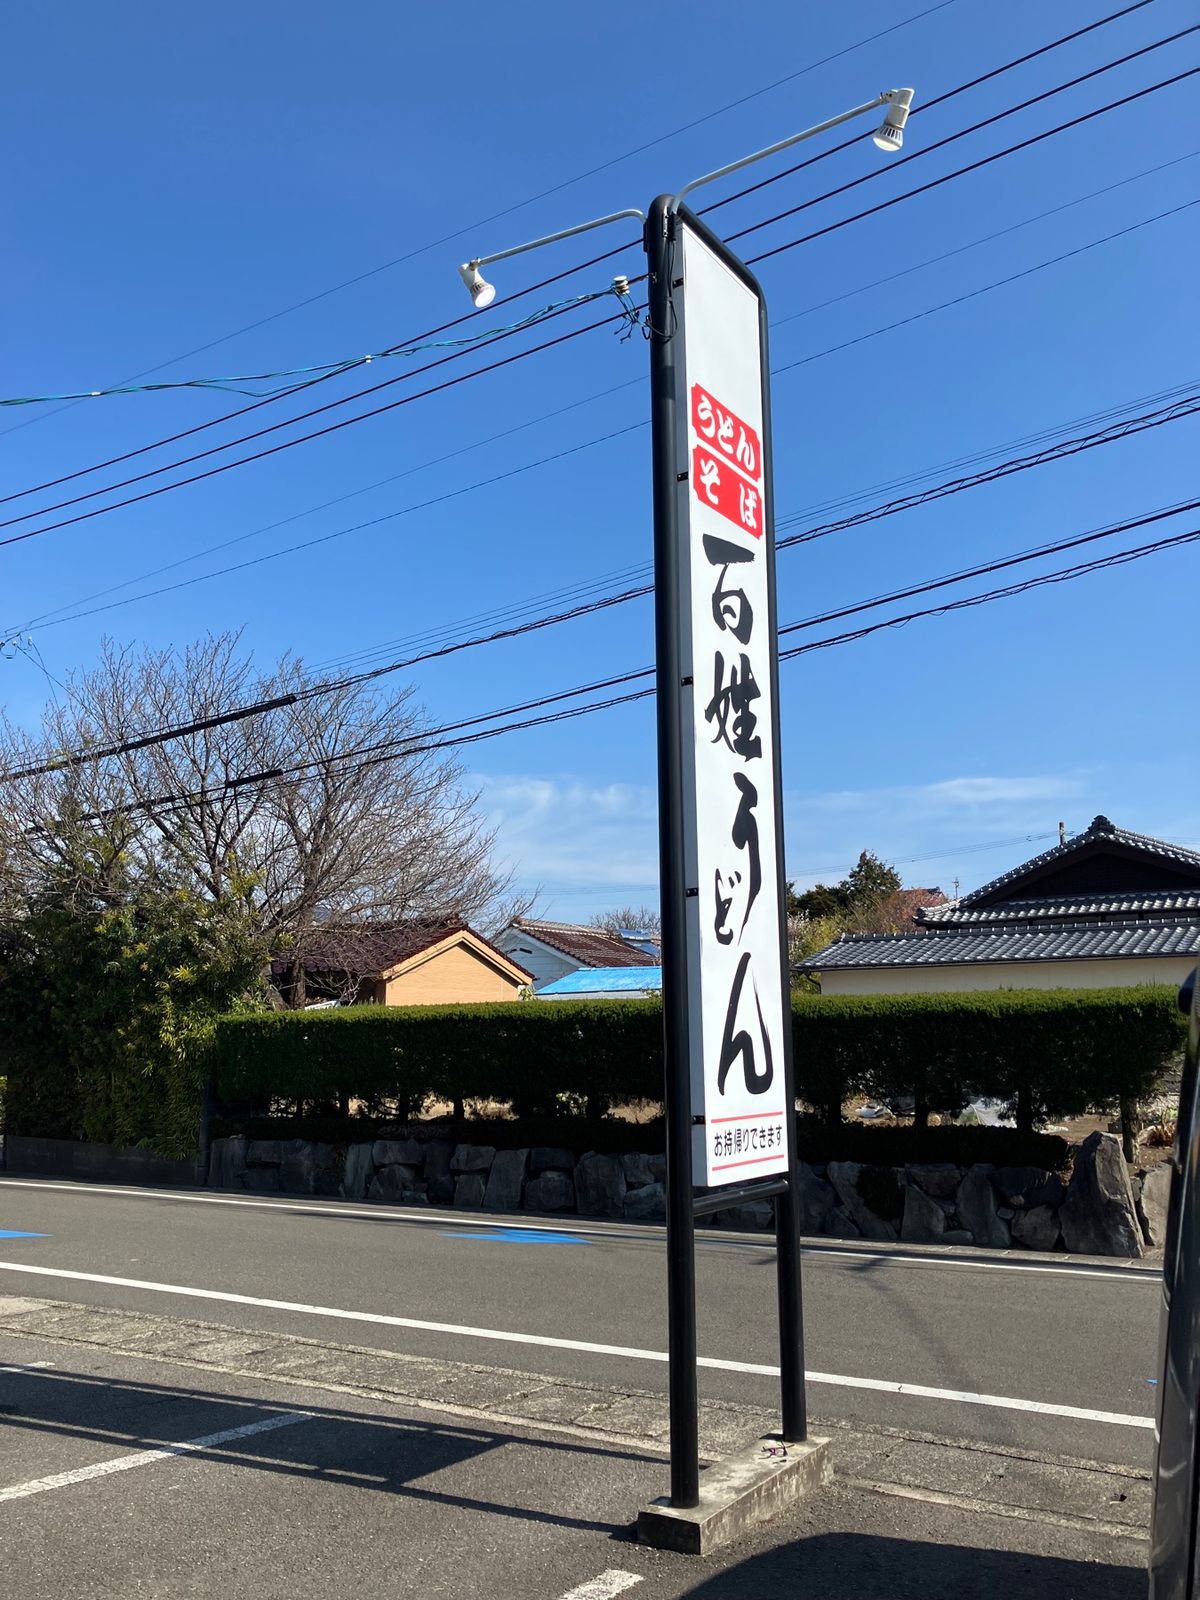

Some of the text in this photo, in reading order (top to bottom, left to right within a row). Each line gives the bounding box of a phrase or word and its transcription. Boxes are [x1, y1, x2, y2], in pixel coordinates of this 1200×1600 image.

[698, 394, 755, 471] うどん
[700, 458, 757, 529] そば
[702, 533, 773, 1096] 百姓うどん
[714, 1124, 782, 1157] お持帰りできます
